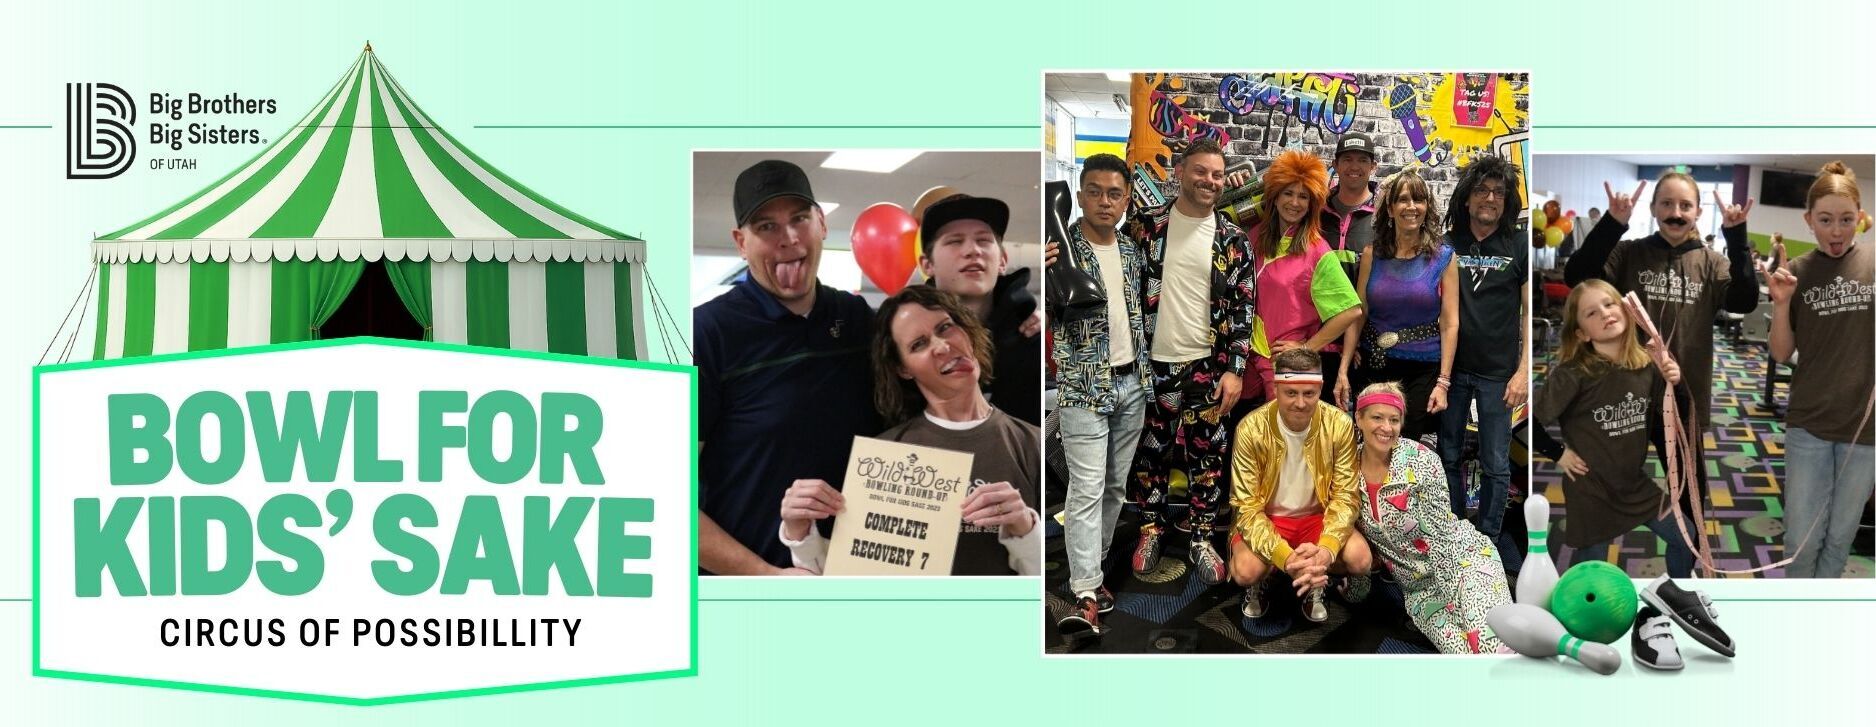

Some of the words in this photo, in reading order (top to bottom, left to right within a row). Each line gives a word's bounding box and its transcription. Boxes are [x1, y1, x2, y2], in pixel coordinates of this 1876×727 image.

[1802, 284, 1836, 304] Wild
[1592, 401, 1627, 422] Wild
[857, 456, 905, 483] Wild
[911, 465, 961, 493] West
[865, 479, 904, 495] BOWLING
[864, 512, 929, 540] COMPLETE
[850, 538, 915, 567] RECOVERY
[920, 552, 930, 570] 7
